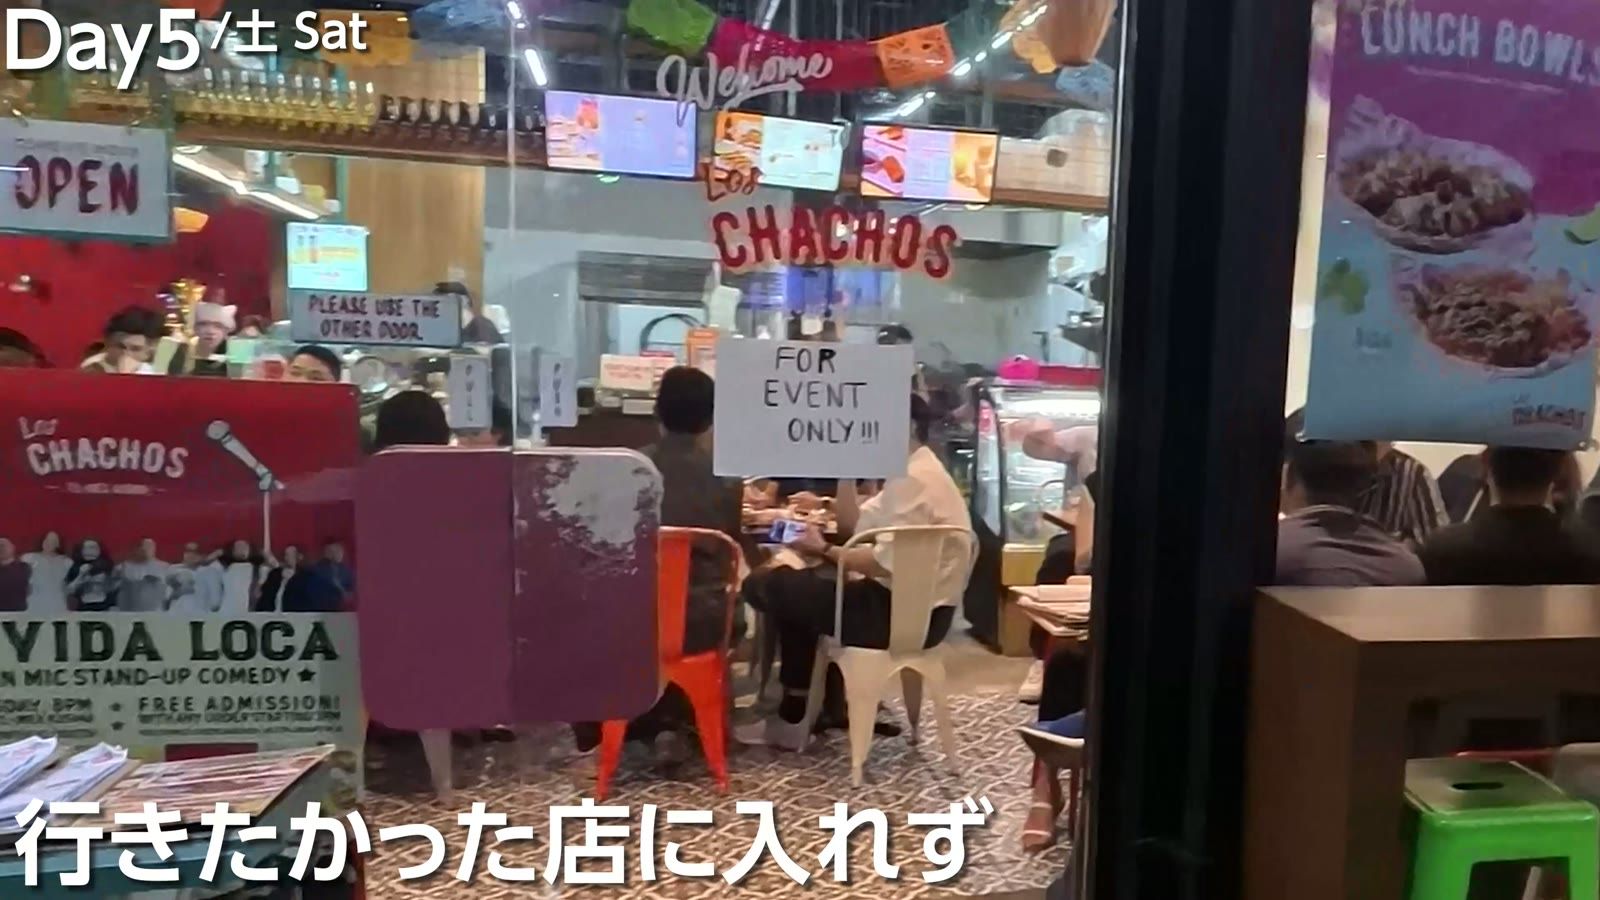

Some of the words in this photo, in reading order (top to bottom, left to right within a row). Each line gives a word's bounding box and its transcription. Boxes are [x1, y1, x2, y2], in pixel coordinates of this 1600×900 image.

[1361, 0, 1480, 57] LUNCH
[656, 42, 833, 127] Welcome
[15, 154, 139, 216] OPEN
[712, 203, 957, 279] CHACHOS
[309, 294, 368, 315] PLEASE
[375, 299, 403, 316] USE
[412, 299, 441, 318] THE
[320, 319, 371, 338] OTHER
[775, 346, 837, 374] FOR
[764, 379, 868, 408] EVENT
[26, 436, 189, 478] CHACHOS
[2, 620, 163, 663] VIDA
[189, 620, 339, 662] LOCA
[197, 667, 291, 686] COMEDY
[138, 696, 195, 712] FREE
